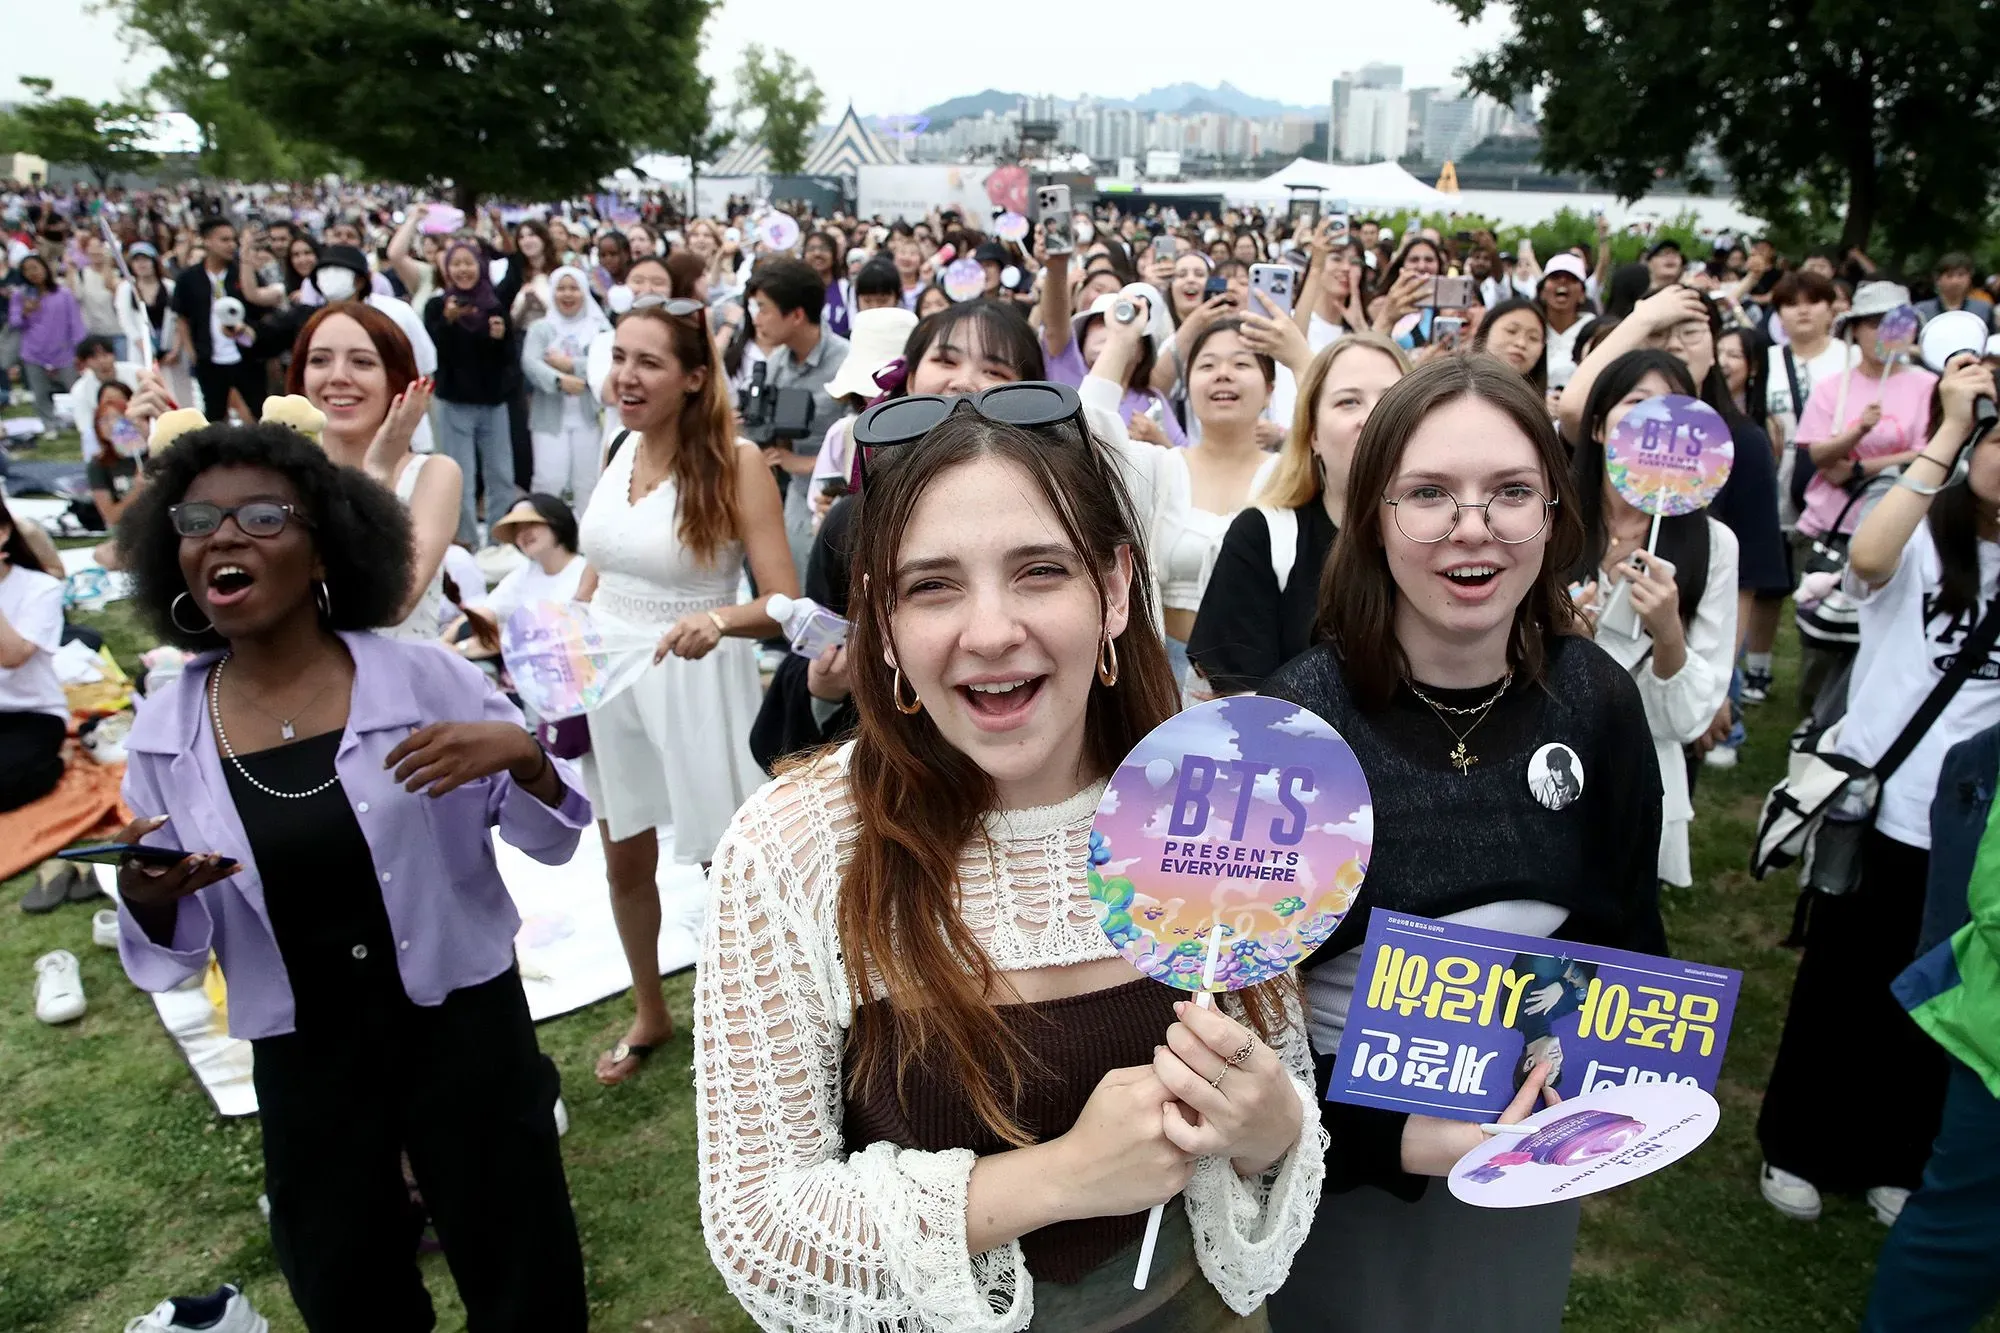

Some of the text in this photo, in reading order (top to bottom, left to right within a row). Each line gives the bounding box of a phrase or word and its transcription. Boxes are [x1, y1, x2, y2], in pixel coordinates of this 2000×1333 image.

[1642, 418, 1705, 457] BTS
[1167, 753, 1316, 847] BTS
[1160, 858, 1297, 882] EVERYWHERE
[1163, 841, 1299, 866] PRESENTS
[1366, 943, 1720, 1057] 남준아 사랑해
[1351, 1028, 1499, 1096] 계절인
[1551, 1112, 1703, 1194] Lip Care Brand in the US
[1615, 1142, 1663, 1166] NO.1
